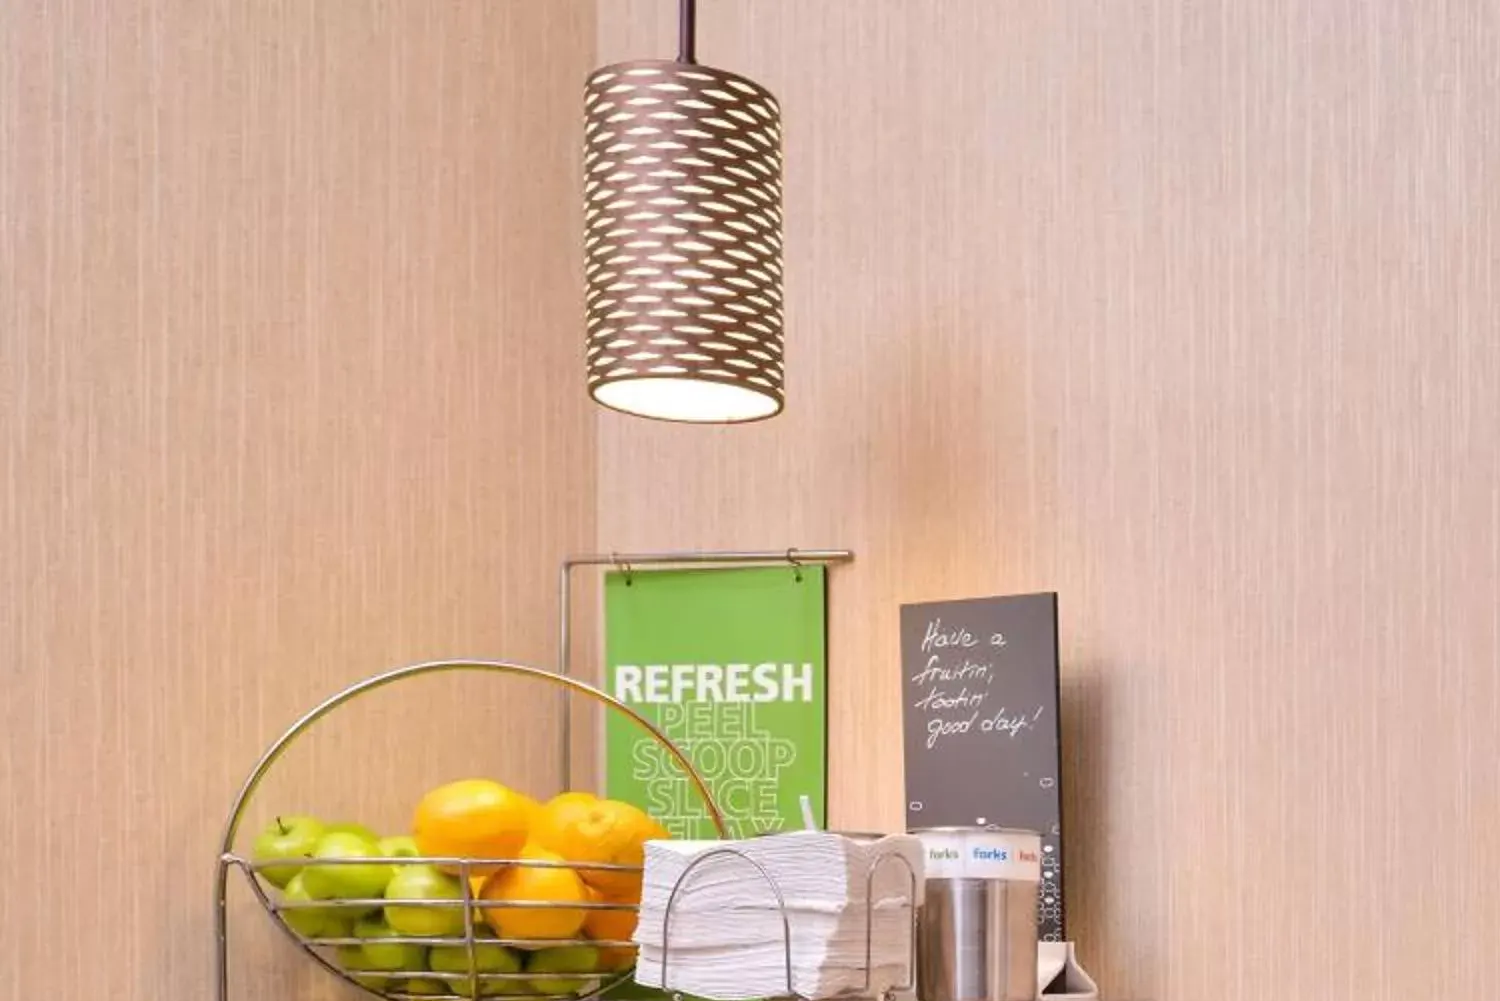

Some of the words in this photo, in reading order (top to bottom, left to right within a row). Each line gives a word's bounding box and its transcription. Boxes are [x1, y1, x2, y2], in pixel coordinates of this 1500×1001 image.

[921, 617, 979, 653] Have
[990, 631, 1007, 646] a
[614, 663, 814, 703] REFRESH
[657, 700, 771, 740] PEEL
[927, 710, 979, 750] good
[980, 705, 1044, 738] day!
[632, 737, 798, 782] SCOOP
[648, 777, 779, 819] SLICE
[971, 846, 1008, 861] forks
